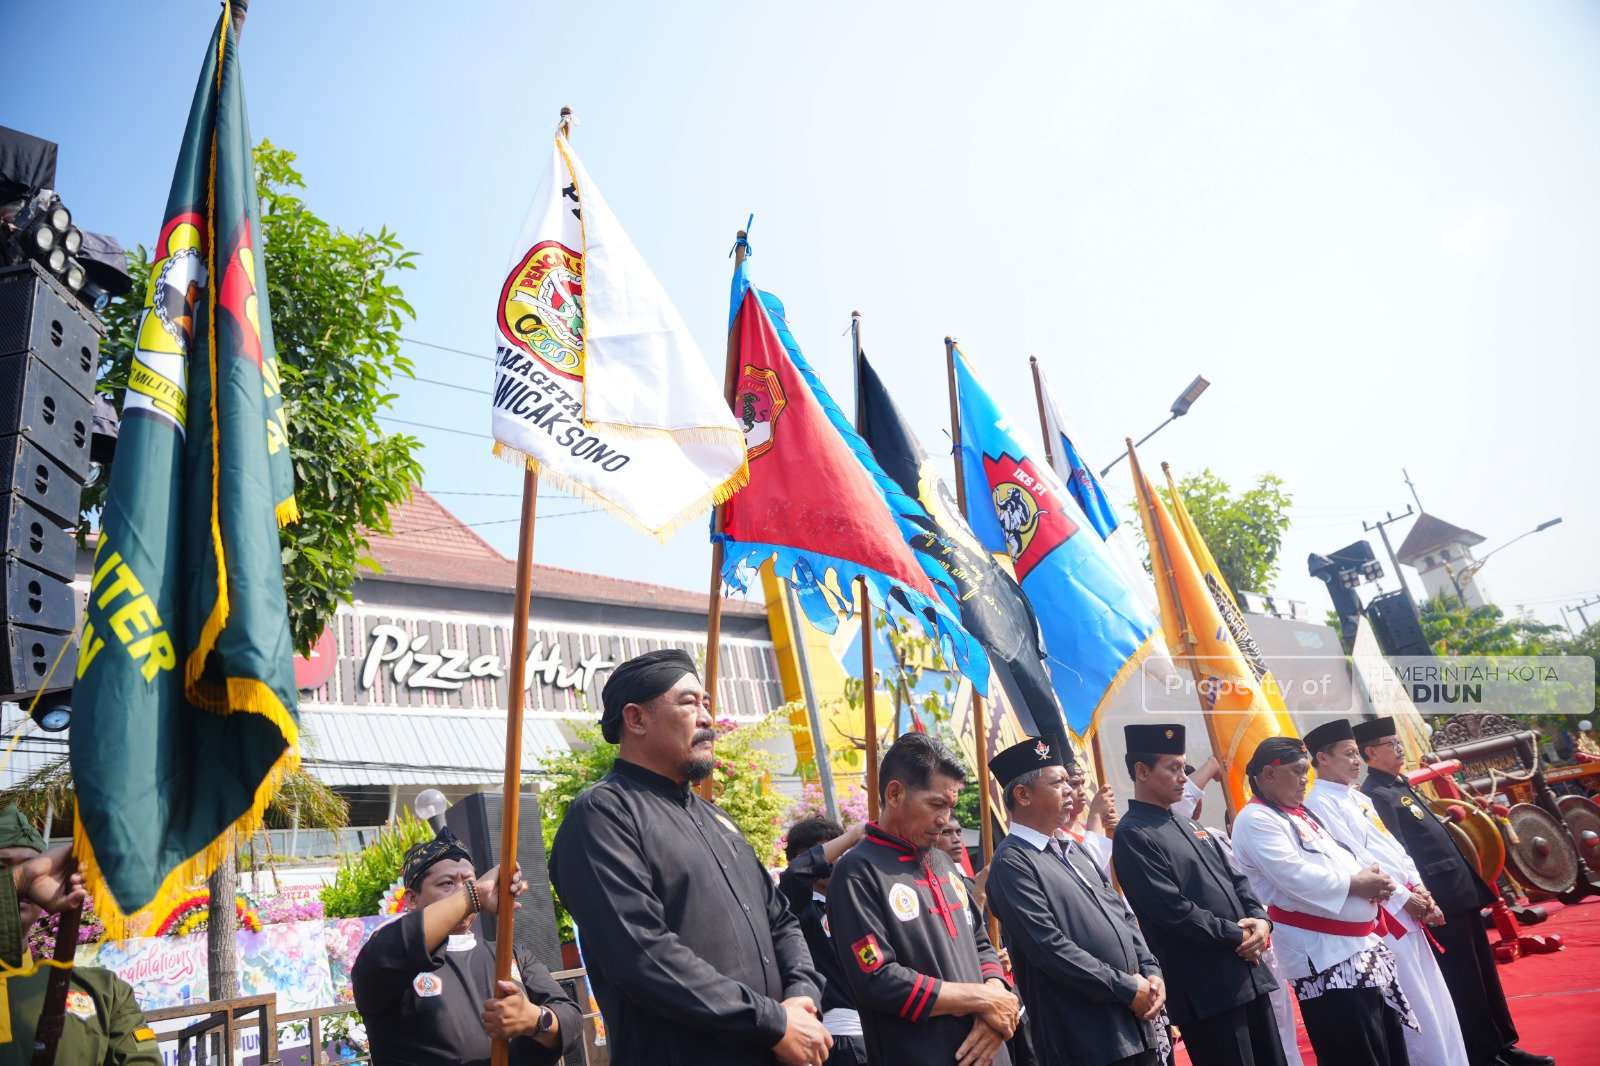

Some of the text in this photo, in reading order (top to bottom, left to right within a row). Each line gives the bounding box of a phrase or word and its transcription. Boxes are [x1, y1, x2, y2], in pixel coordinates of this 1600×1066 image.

[493, 373, 631, 472] WICAKSONO
[1012, 468, 1035, 487] IKS
[362, 624, 614, 691] Pizza Hut
[119, 943, 194, 982] ratulations
